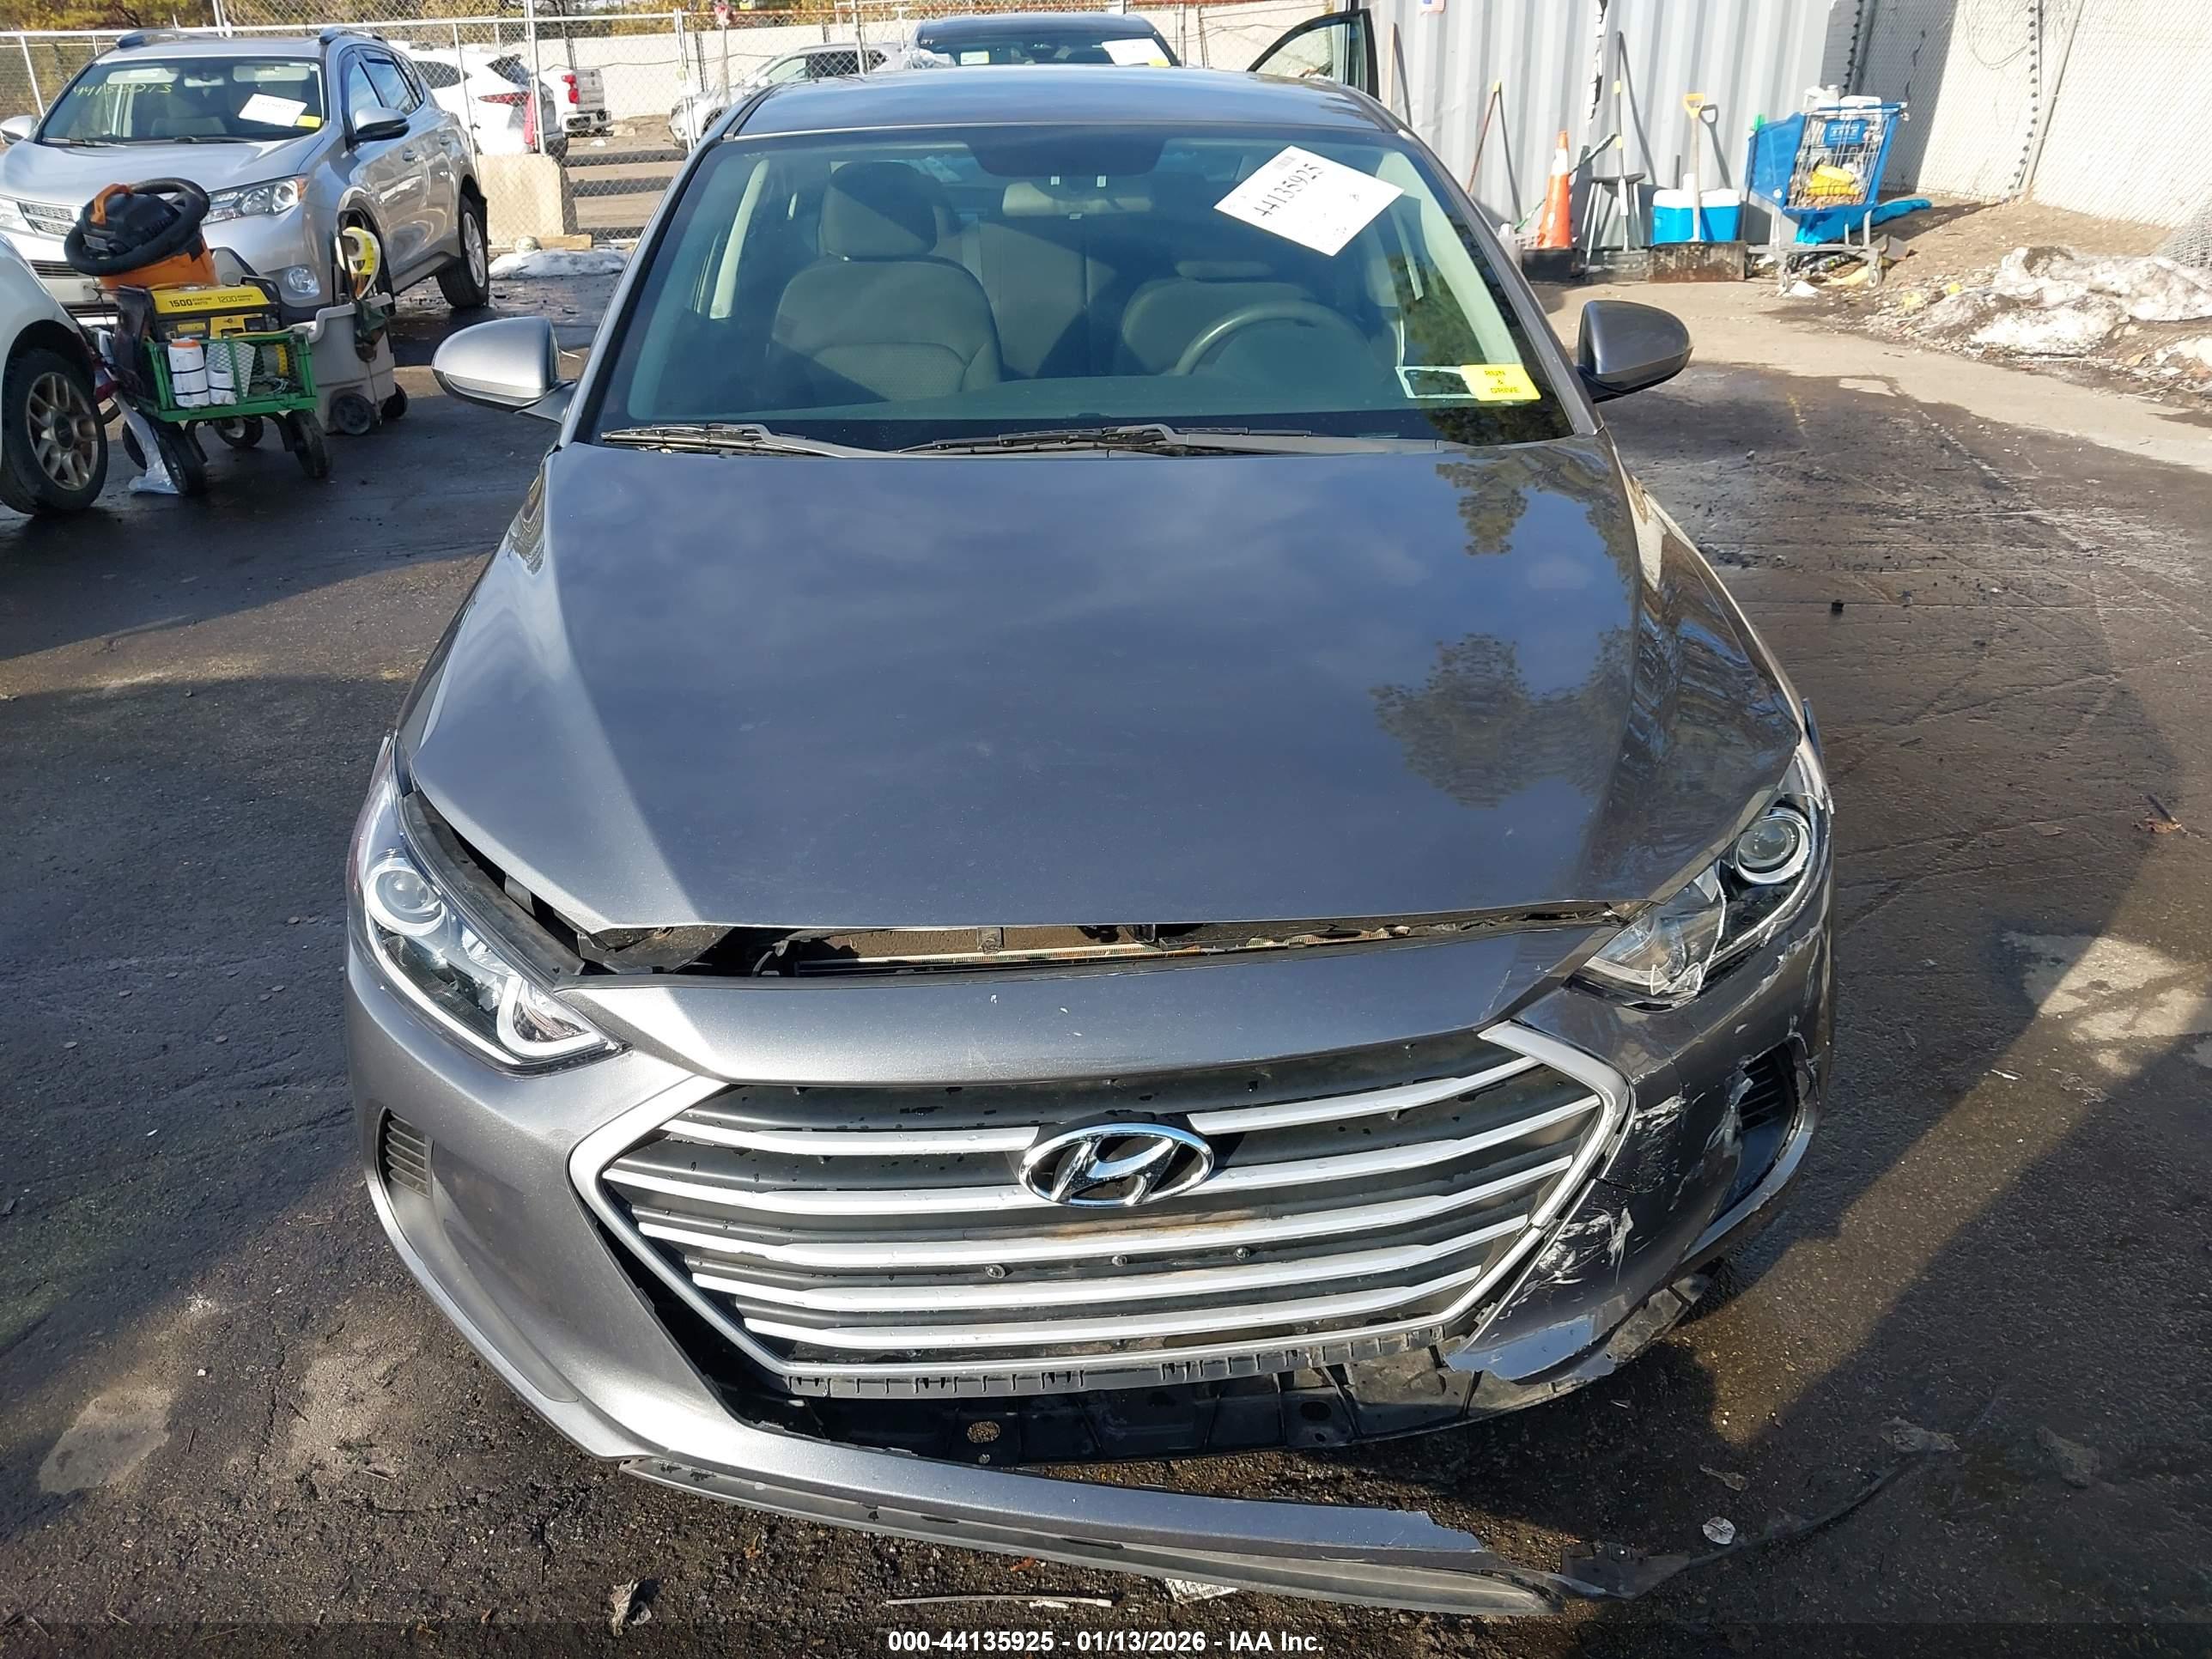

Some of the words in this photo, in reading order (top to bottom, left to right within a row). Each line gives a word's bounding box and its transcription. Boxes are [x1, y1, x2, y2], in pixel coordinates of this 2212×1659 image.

[1253, 163, 1325, 216] 44135925
[168, 298, 193, 308] 1500
[216, 295, 238, 303] 1200
